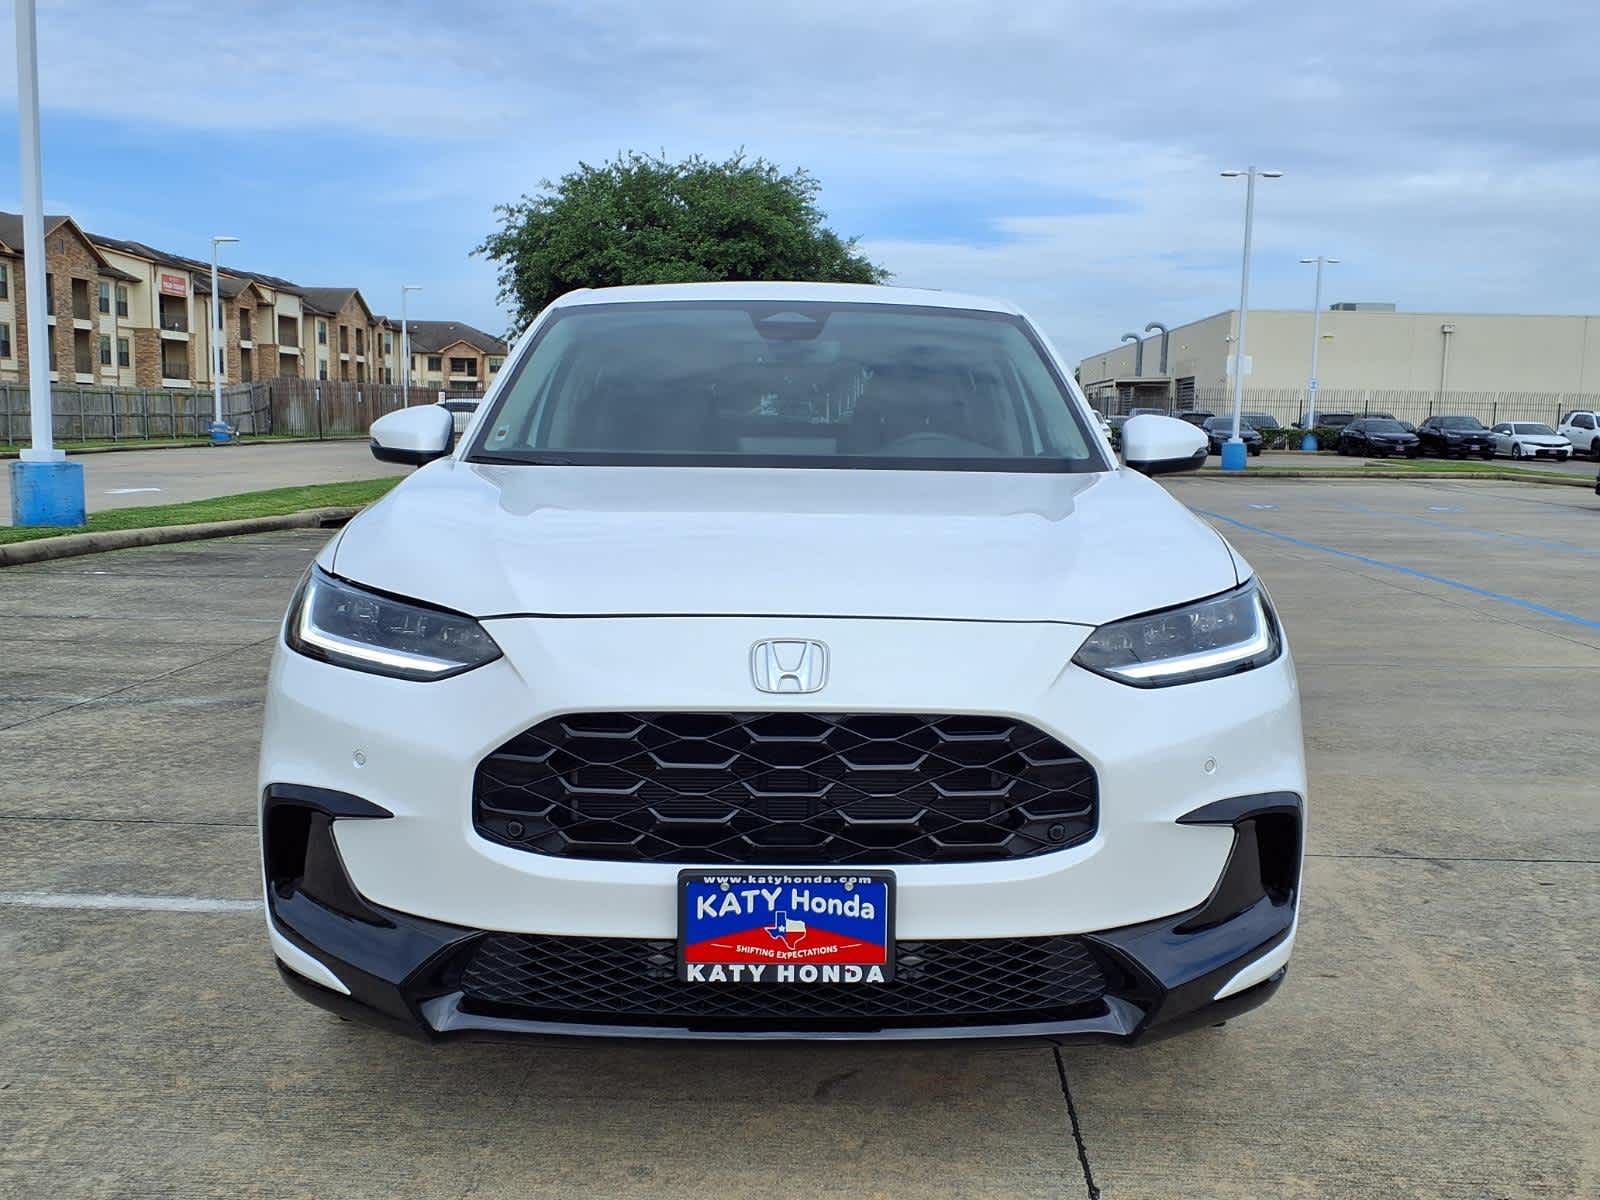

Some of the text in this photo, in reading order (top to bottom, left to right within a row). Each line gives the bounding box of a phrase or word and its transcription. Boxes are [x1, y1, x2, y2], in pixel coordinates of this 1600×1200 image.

[703, 875, 872, 884] www.katyhonda.com
[697, 887, 875, 919] KATY Honda
[736, 945, 838, 959] SHIFTING EXPECTATIONS
[687, 965, 885, 982] KATY HONDA
